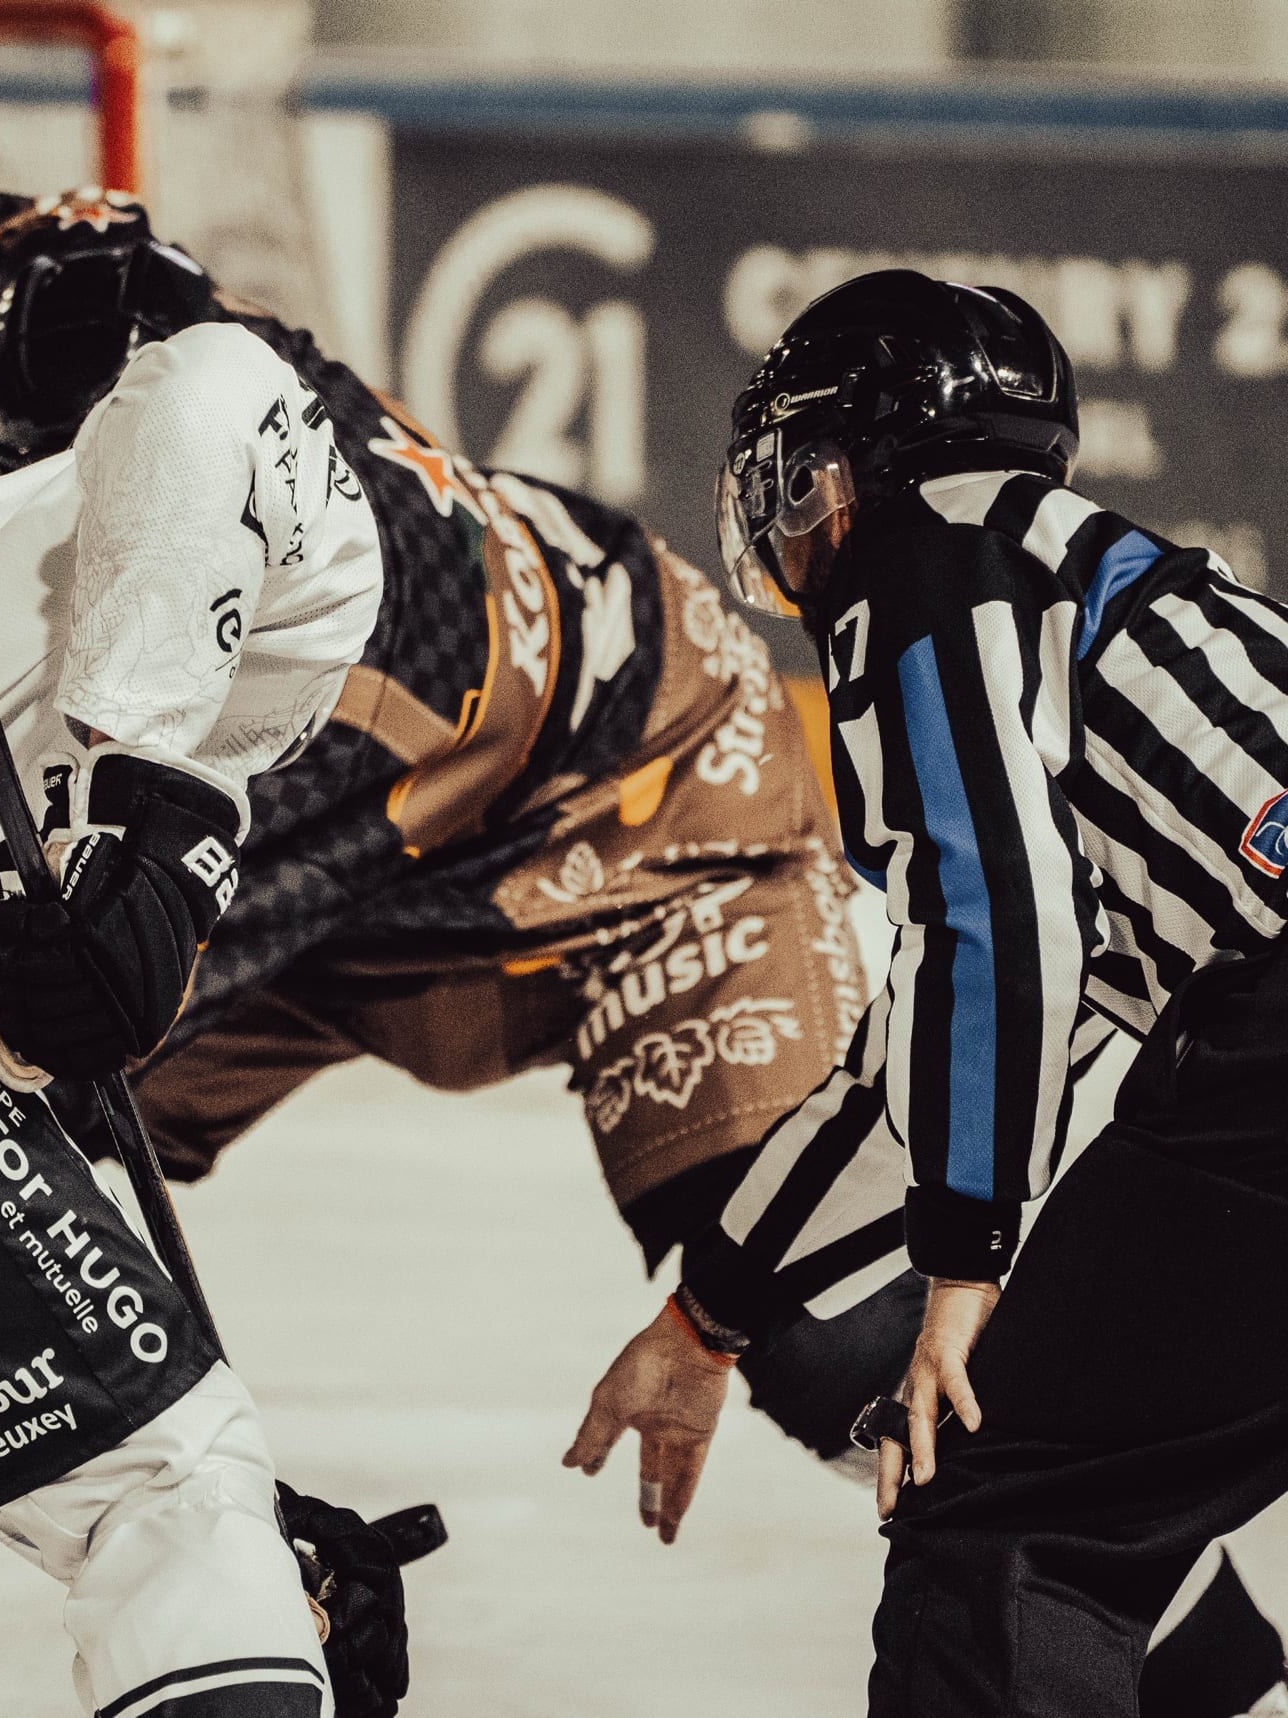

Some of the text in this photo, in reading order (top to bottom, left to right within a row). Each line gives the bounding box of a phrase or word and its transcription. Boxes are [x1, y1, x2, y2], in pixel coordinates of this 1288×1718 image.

[791, 386, 839, 403] WARRIOR
[62, 832, 101, 901] BAUER
[0, 1200, 25, 1230] et
[18, 1229, 99, 1334] mutuelle
[46, 1209, 168, 1364] HUGO
